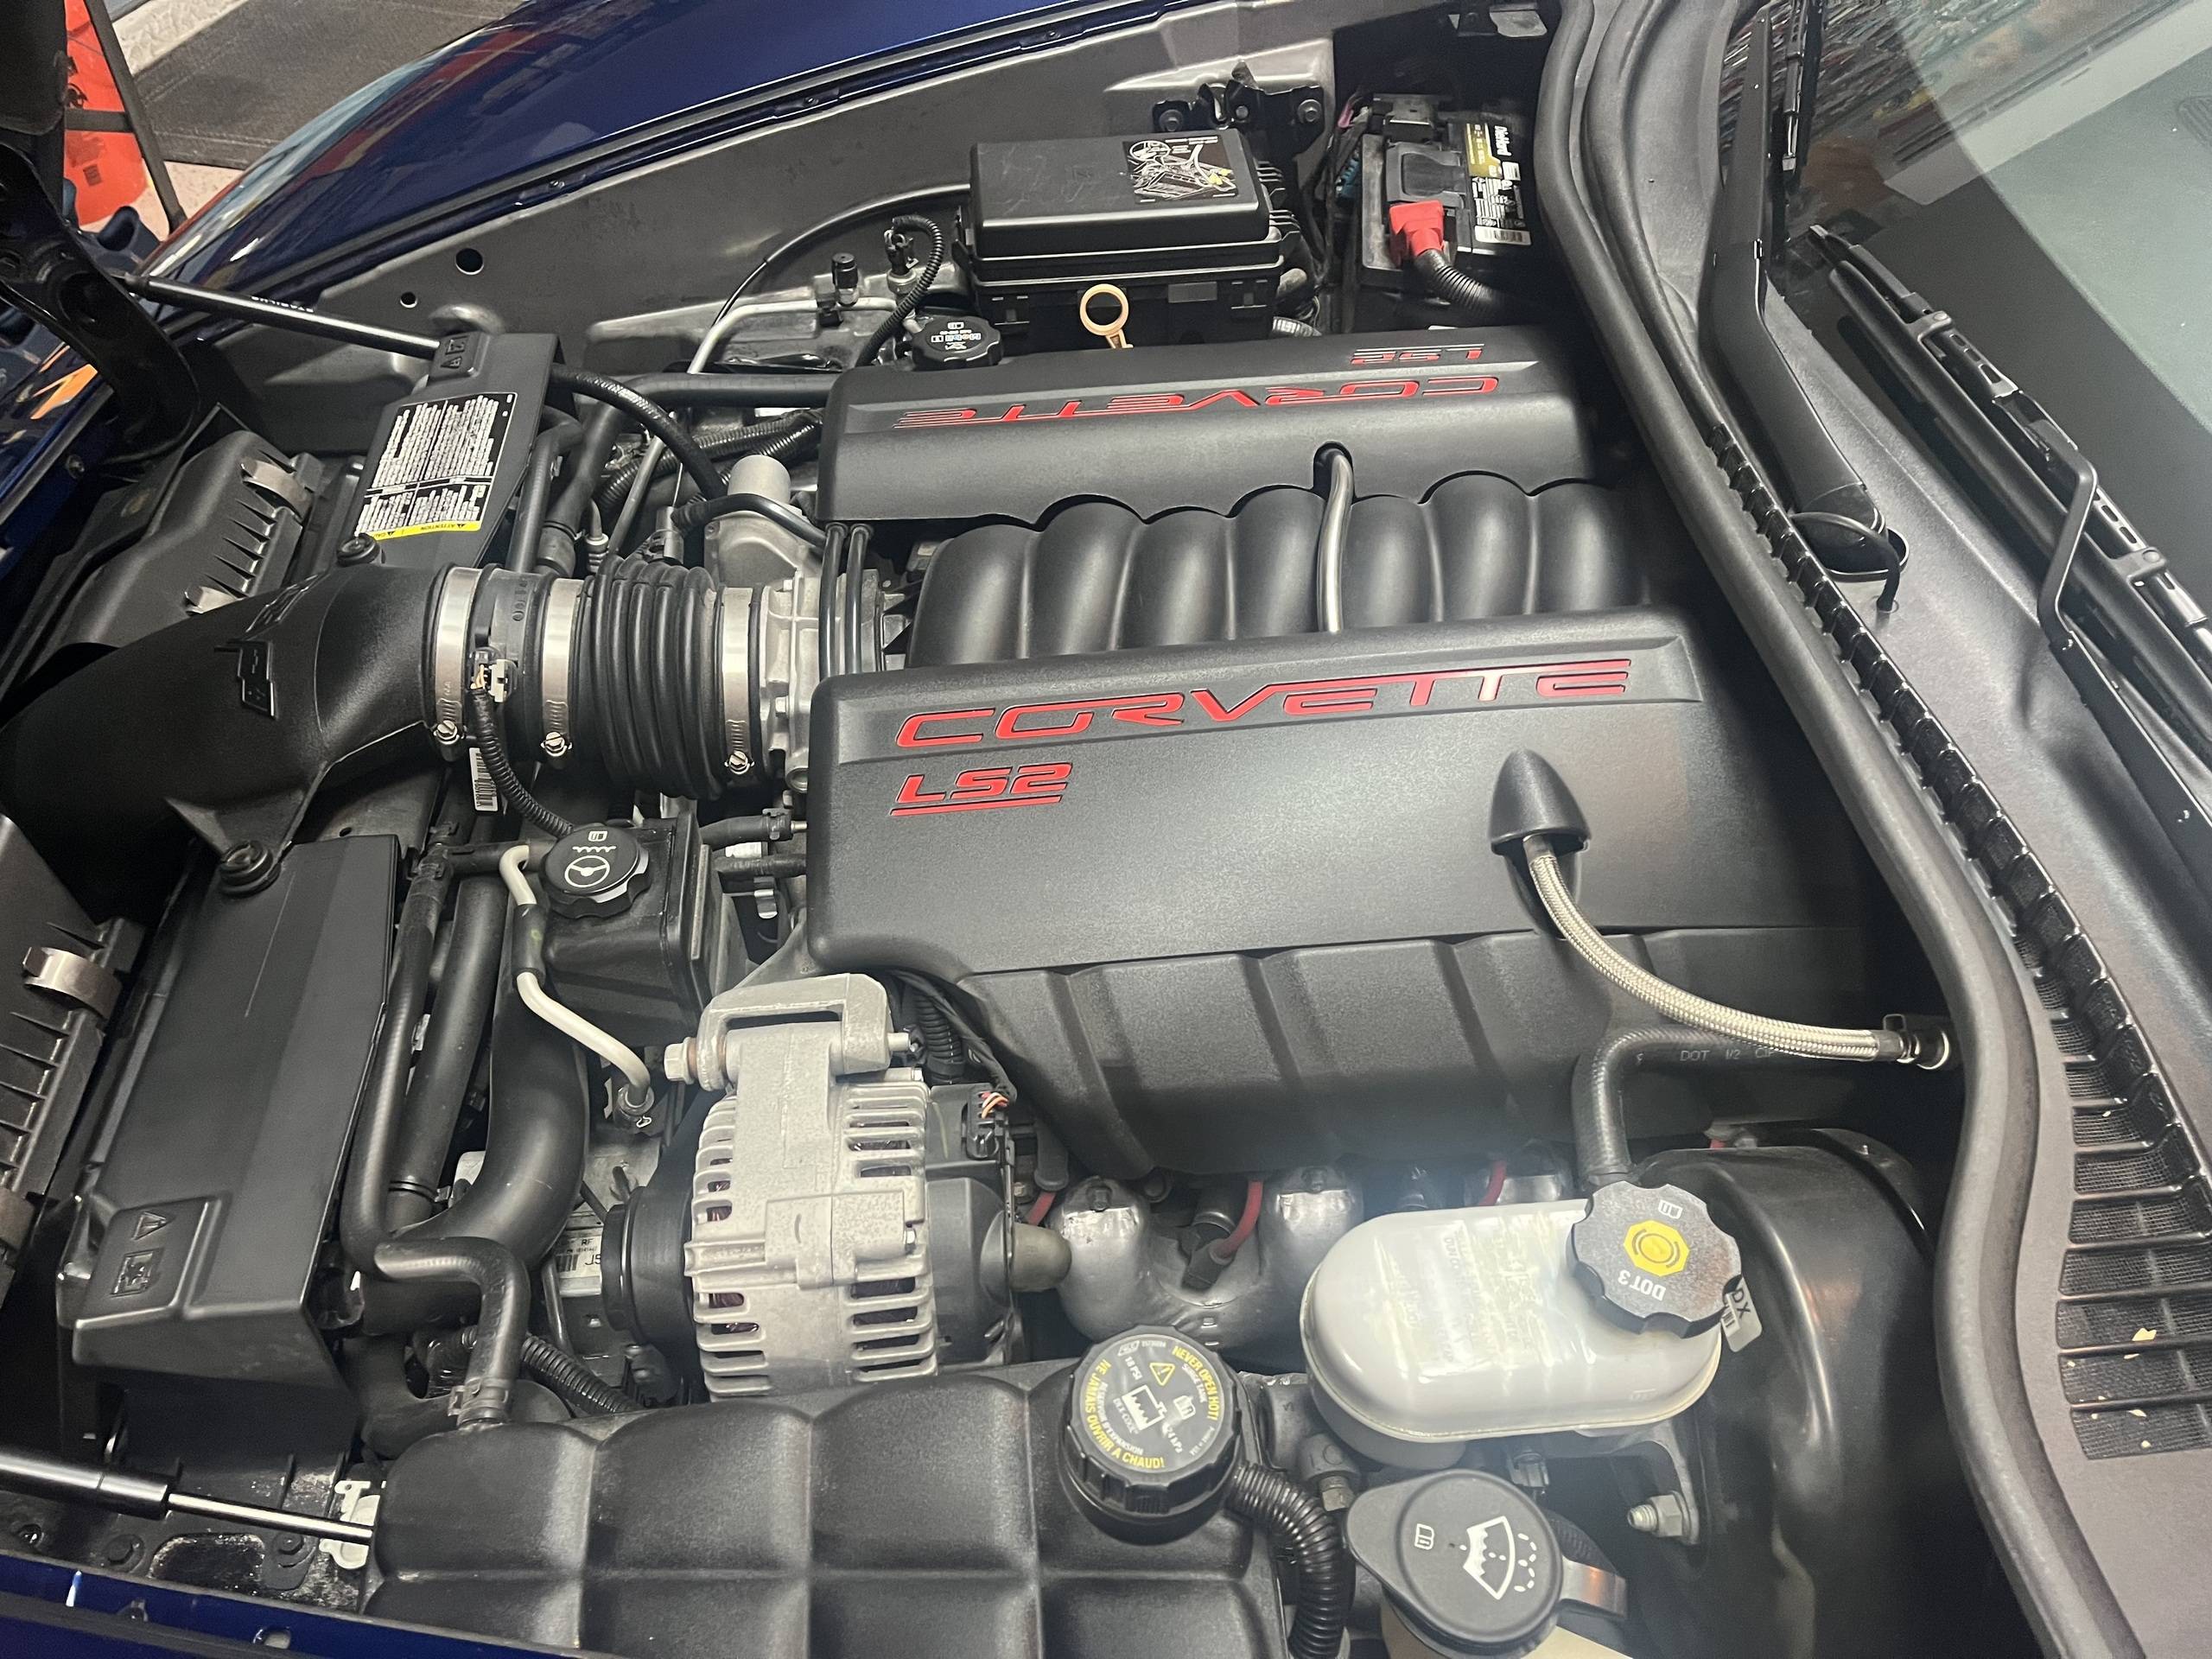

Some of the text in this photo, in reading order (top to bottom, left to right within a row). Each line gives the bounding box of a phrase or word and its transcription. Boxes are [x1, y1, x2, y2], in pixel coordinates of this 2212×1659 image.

[1494, 125, 1512, 156] DieHard
[1350, 346, 1484, 366] LS2
[893, 376, 1499, 429] CORVETTE
[896, 658, 1631, 748] CORVETTE
[895, 761, 1074, 805] LS2
[1680, 1049, 1710, 1061] DOT
[1618, 1269, 1667, 1301] DOT 3
[1732, 1287, 1751, 1319] DX
[1095, 1358, 1111, 1375] NE
[1129, 1365, 1142, 1380] PSI
[1085, 1372, 1101, 1413] JAMAIS
[1172, 1345, 1219, 1421] NEVER OPEN HOT!
[1087, 1414, 1115, 1452] OUVRIR
[1122, 1452, 1165, 1468] CHAUD!
